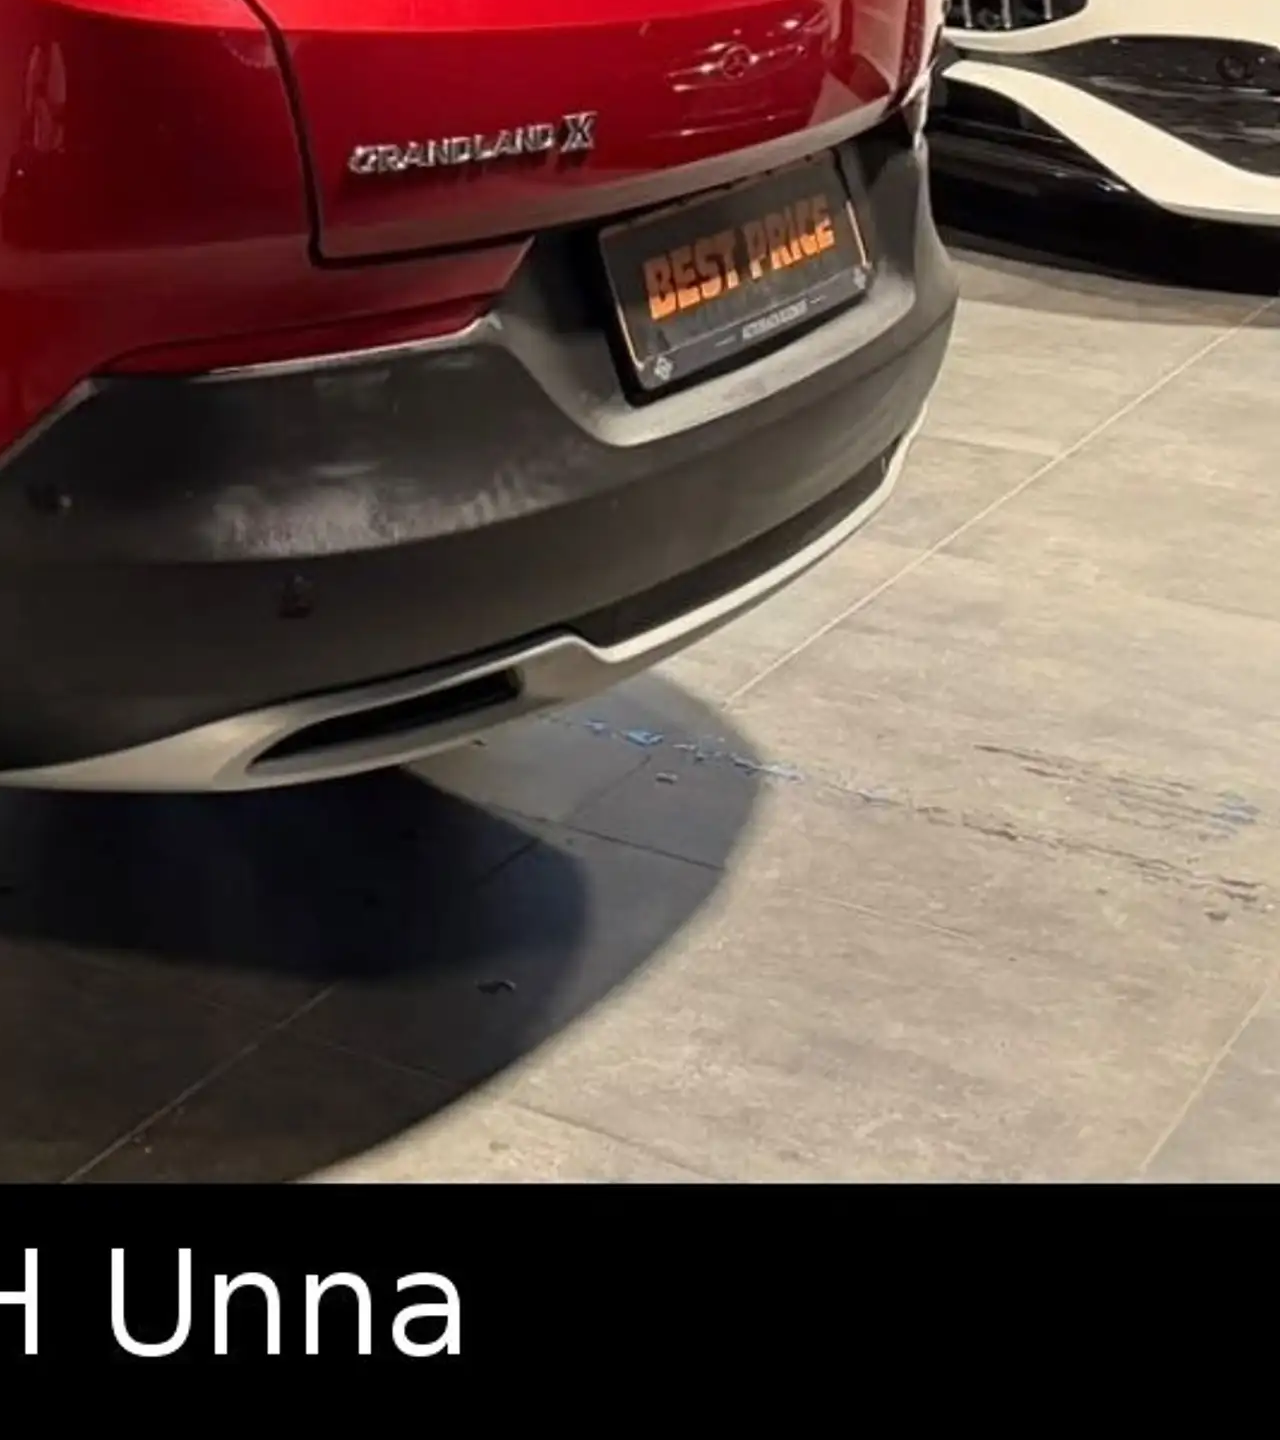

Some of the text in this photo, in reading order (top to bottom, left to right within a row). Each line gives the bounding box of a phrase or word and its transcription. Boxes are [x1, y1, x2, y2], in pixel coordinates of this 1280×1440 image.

[348, 111, 598, 174] GRANDLAND X
[643, 228, 740, 321] BEST
[743, 194, 835, 280] PRICE
